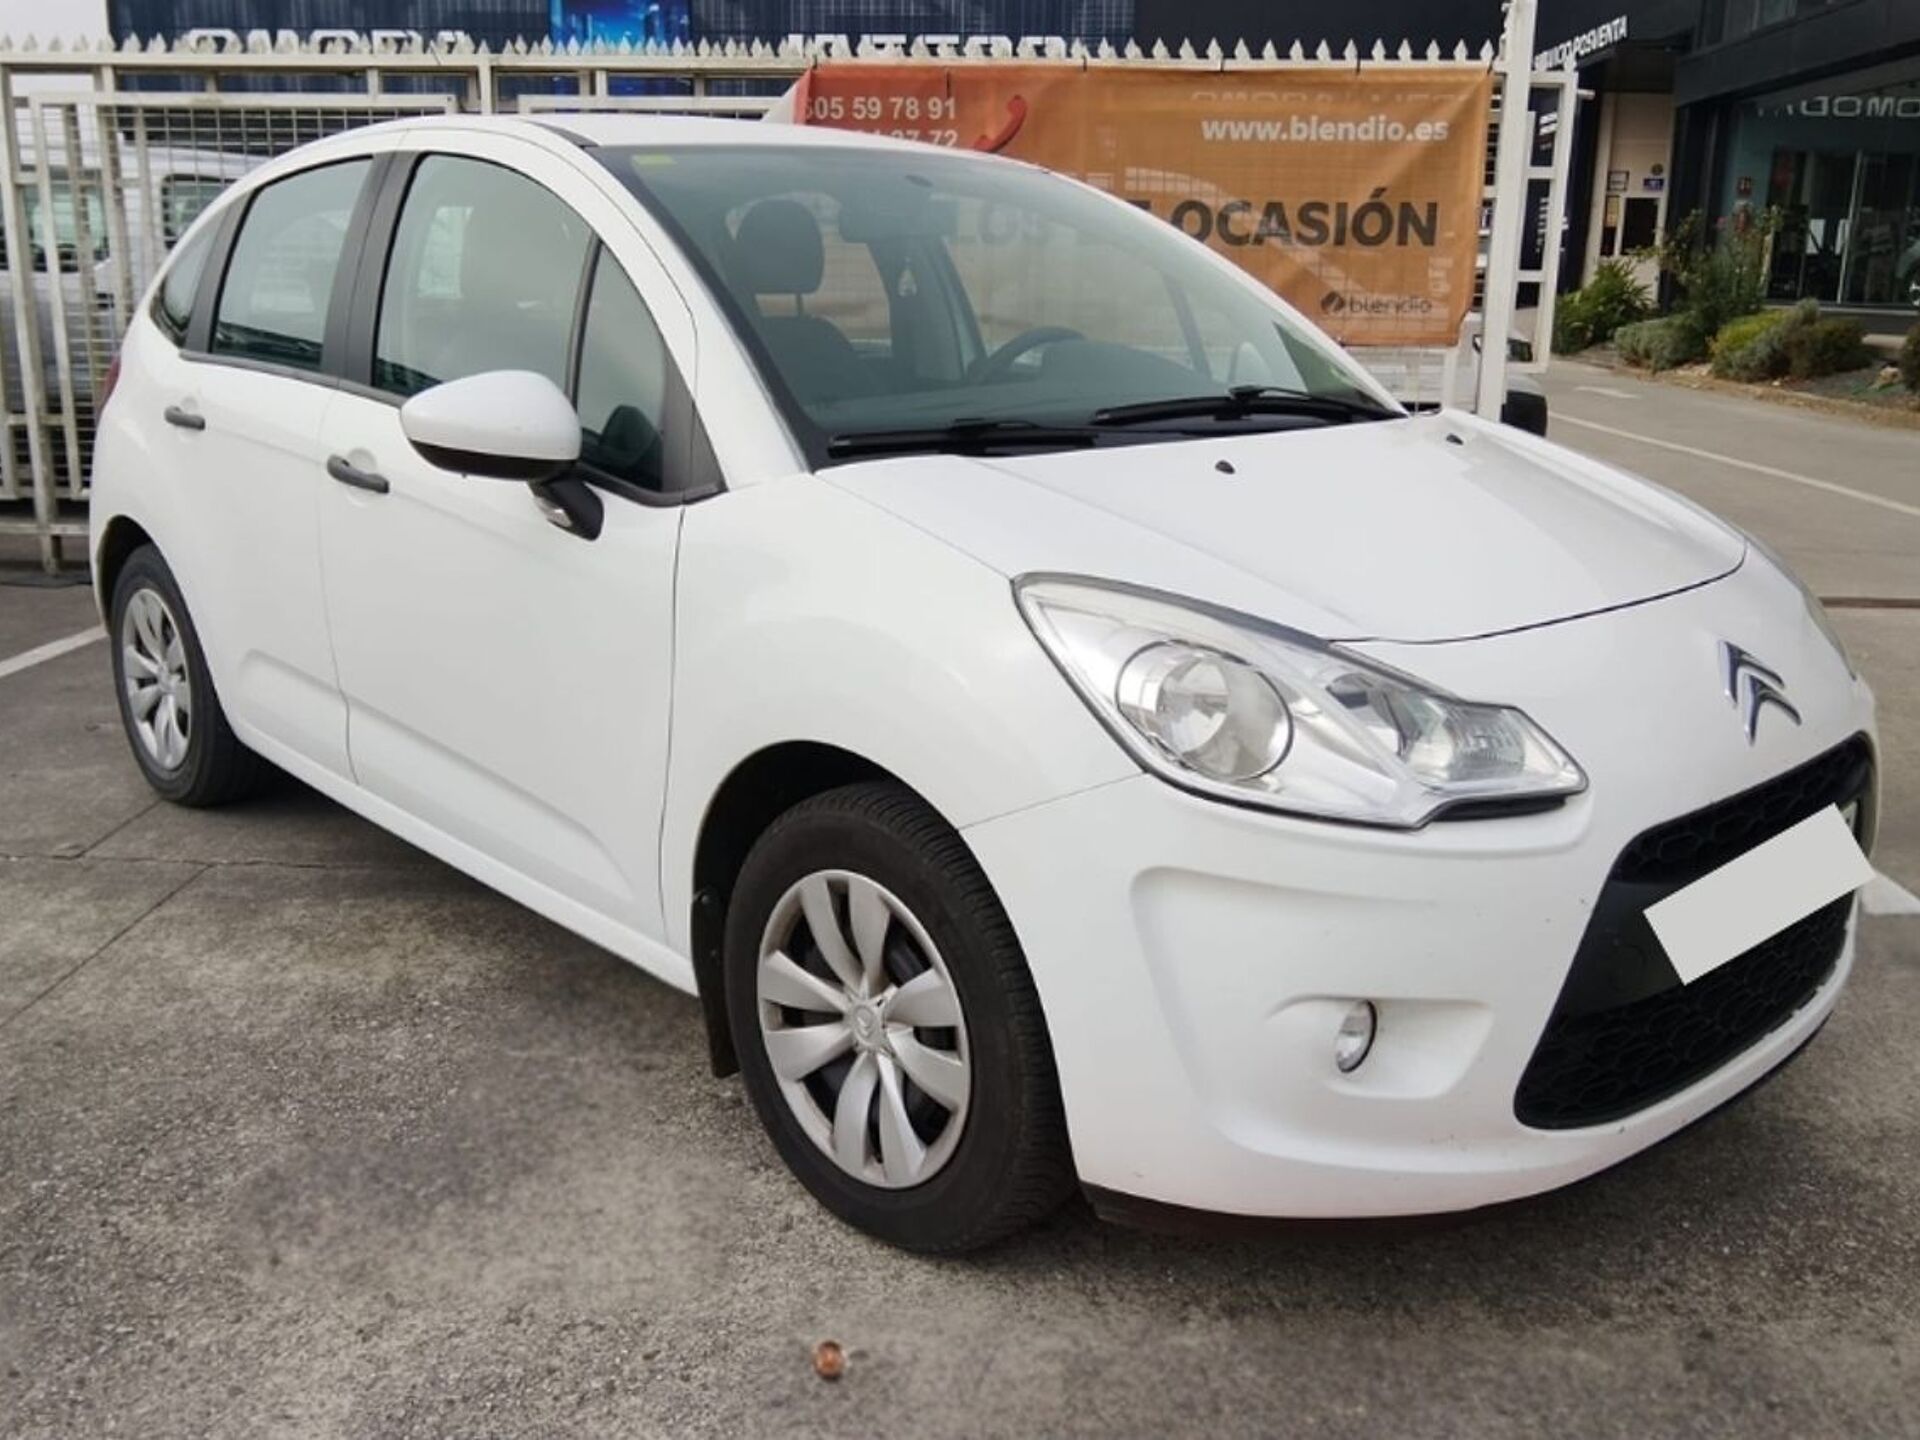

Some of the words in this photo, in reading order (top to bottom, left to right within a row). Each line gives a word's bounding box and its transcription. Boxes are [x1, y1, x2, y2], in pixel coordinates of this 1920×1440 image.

[852, 97, 882, 120] 59
[889, 97, 920, 120] 78
[928, 97, 956, 120] 91
[1201, 115, 1449, 142] www.blendio.es
[1171, 187, 1438, 248] OCASIÓN
